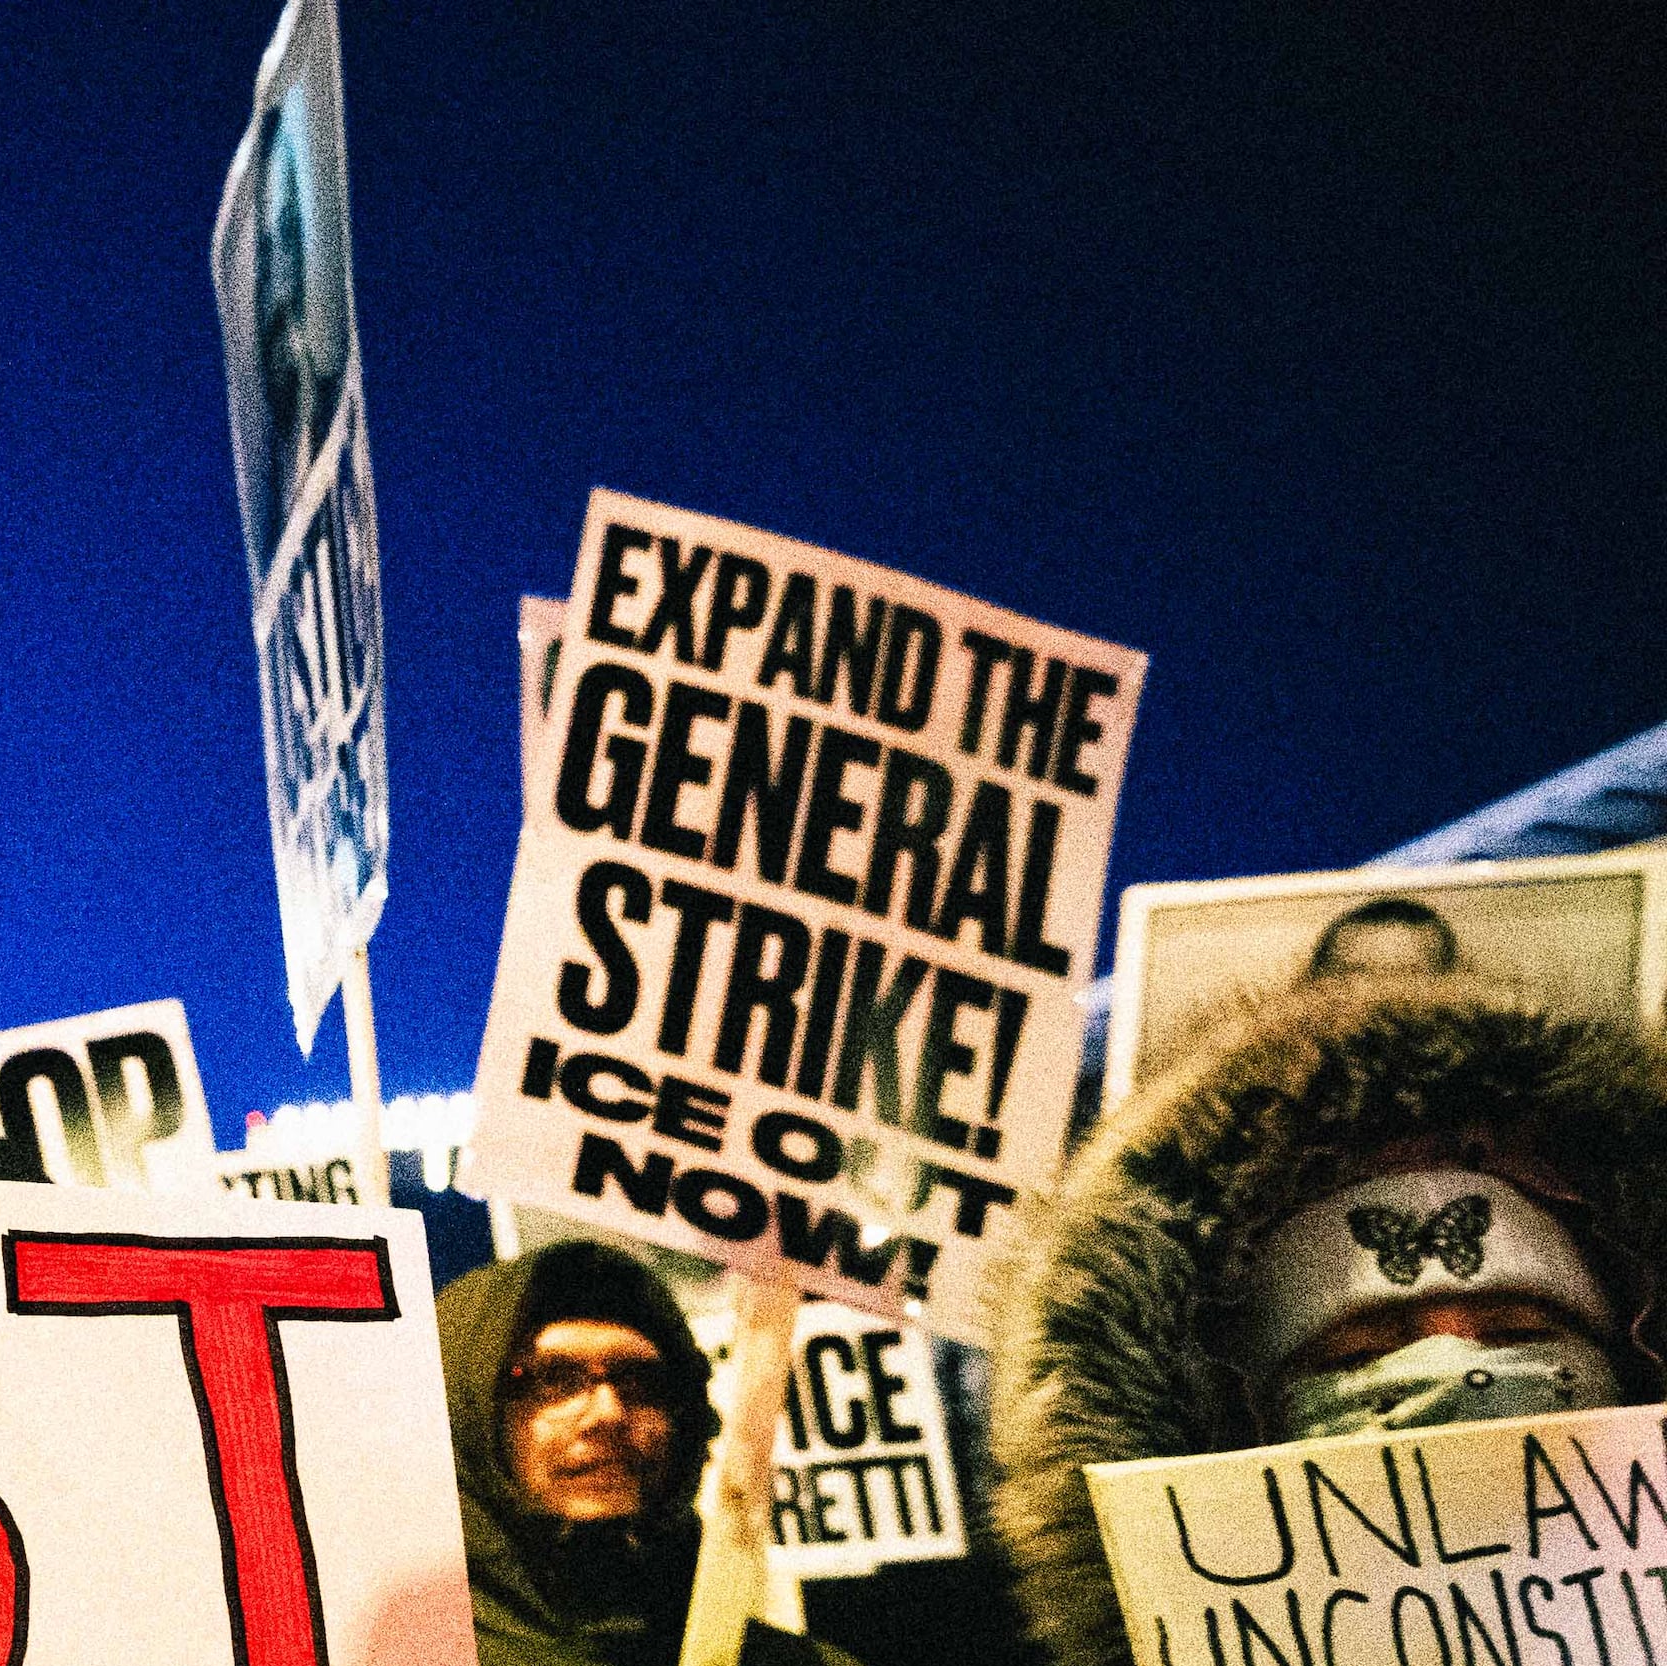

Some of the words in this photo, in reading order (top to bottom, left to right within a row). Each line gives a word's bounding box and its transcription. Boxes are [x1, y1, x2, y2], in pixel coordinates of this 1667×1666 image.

[588, 522, 941, 733] EXPAND
[957, 629, 1118, 796] THE
[554, 661, 1071, 976] GENERAL
[556, 859, 1030, 1160] STRIKE!
[520, 1039, 731, 1152] ICE
[574, 1133, 941, 1301] NOW!
[784, 1331, 921, 1450] ICE
[1167, 1417, 1667, 1587] UNLAW
